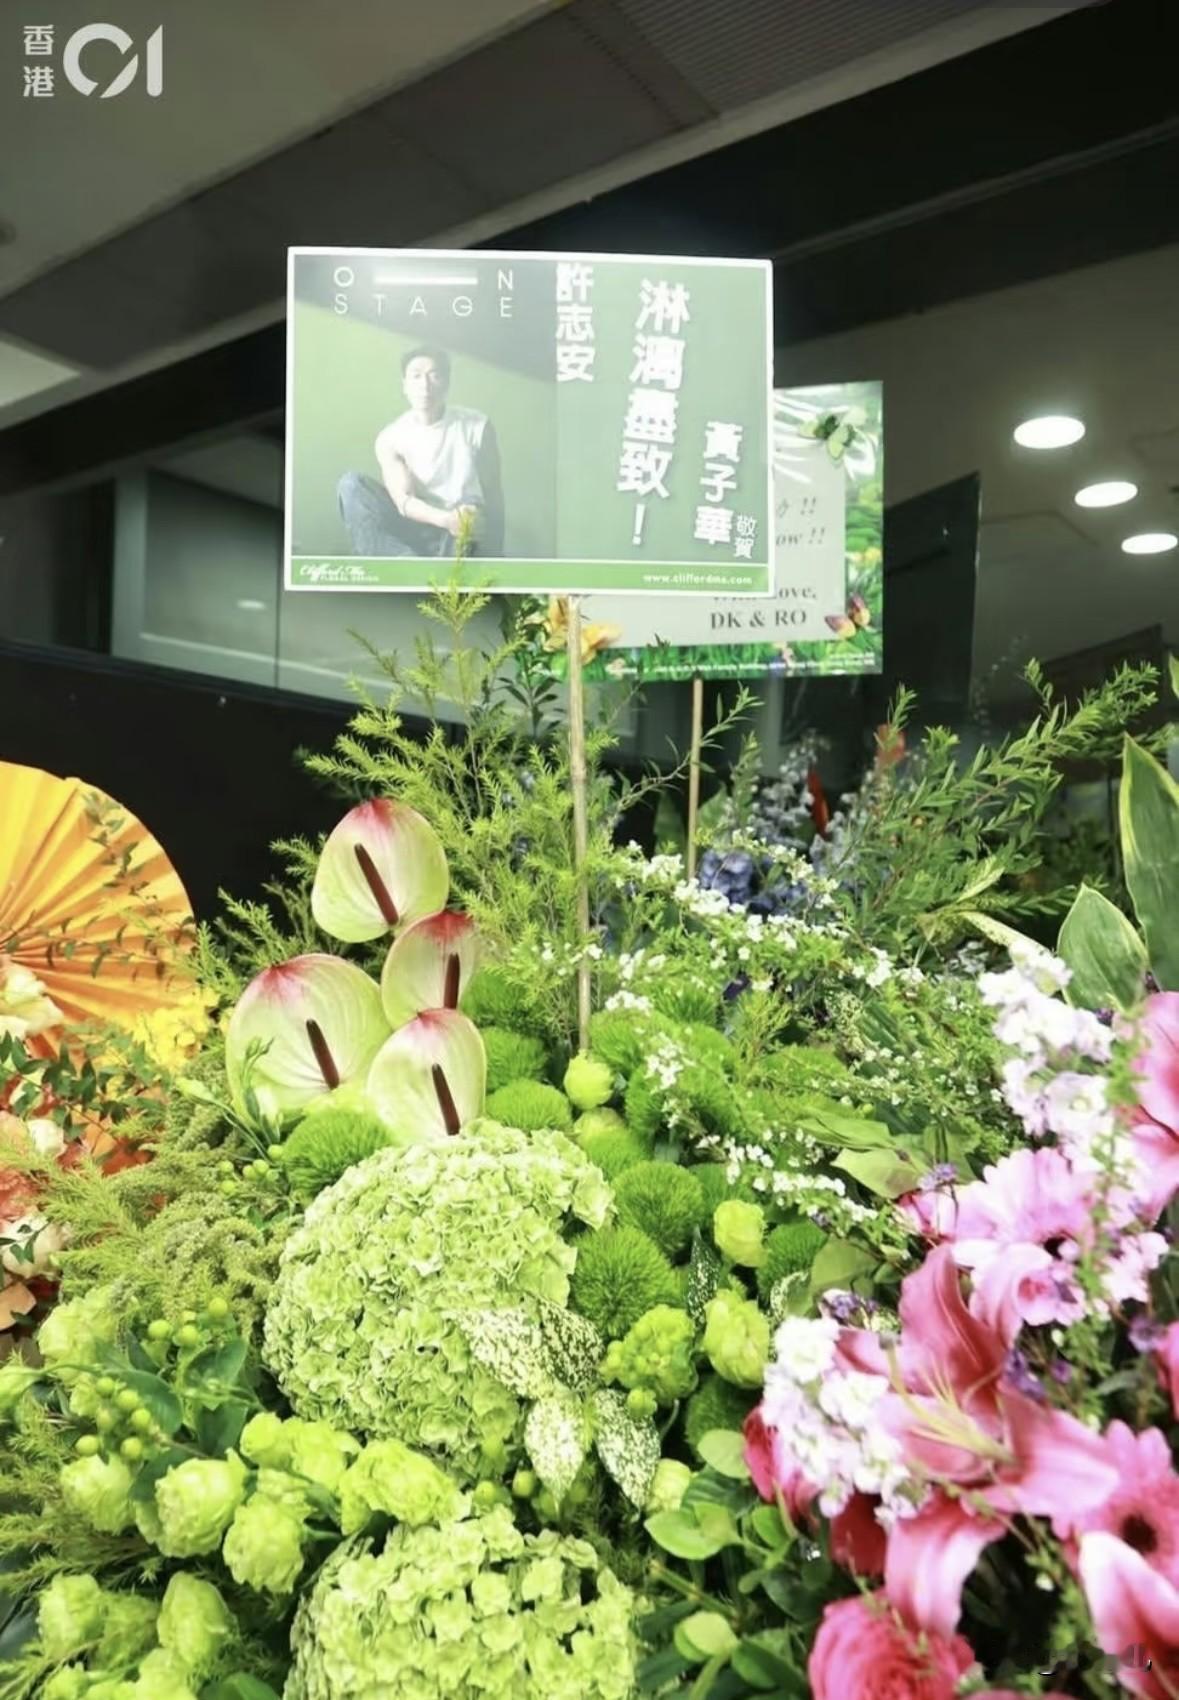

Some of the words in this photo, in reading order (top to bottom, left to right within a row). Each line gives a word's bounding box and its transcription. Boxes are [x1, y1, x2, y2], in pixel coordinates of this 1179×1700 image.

[333, 293, 514, 318] STAGE
[555, 262, 595, 382] 許志安
[733, 515, 757, 559] 敬賀
[778, 587, 817, 599] ove,
[710, 611, 742, 629] DK
[749, 611, 765, 627] &
[775, 609, 807, 626] RO
